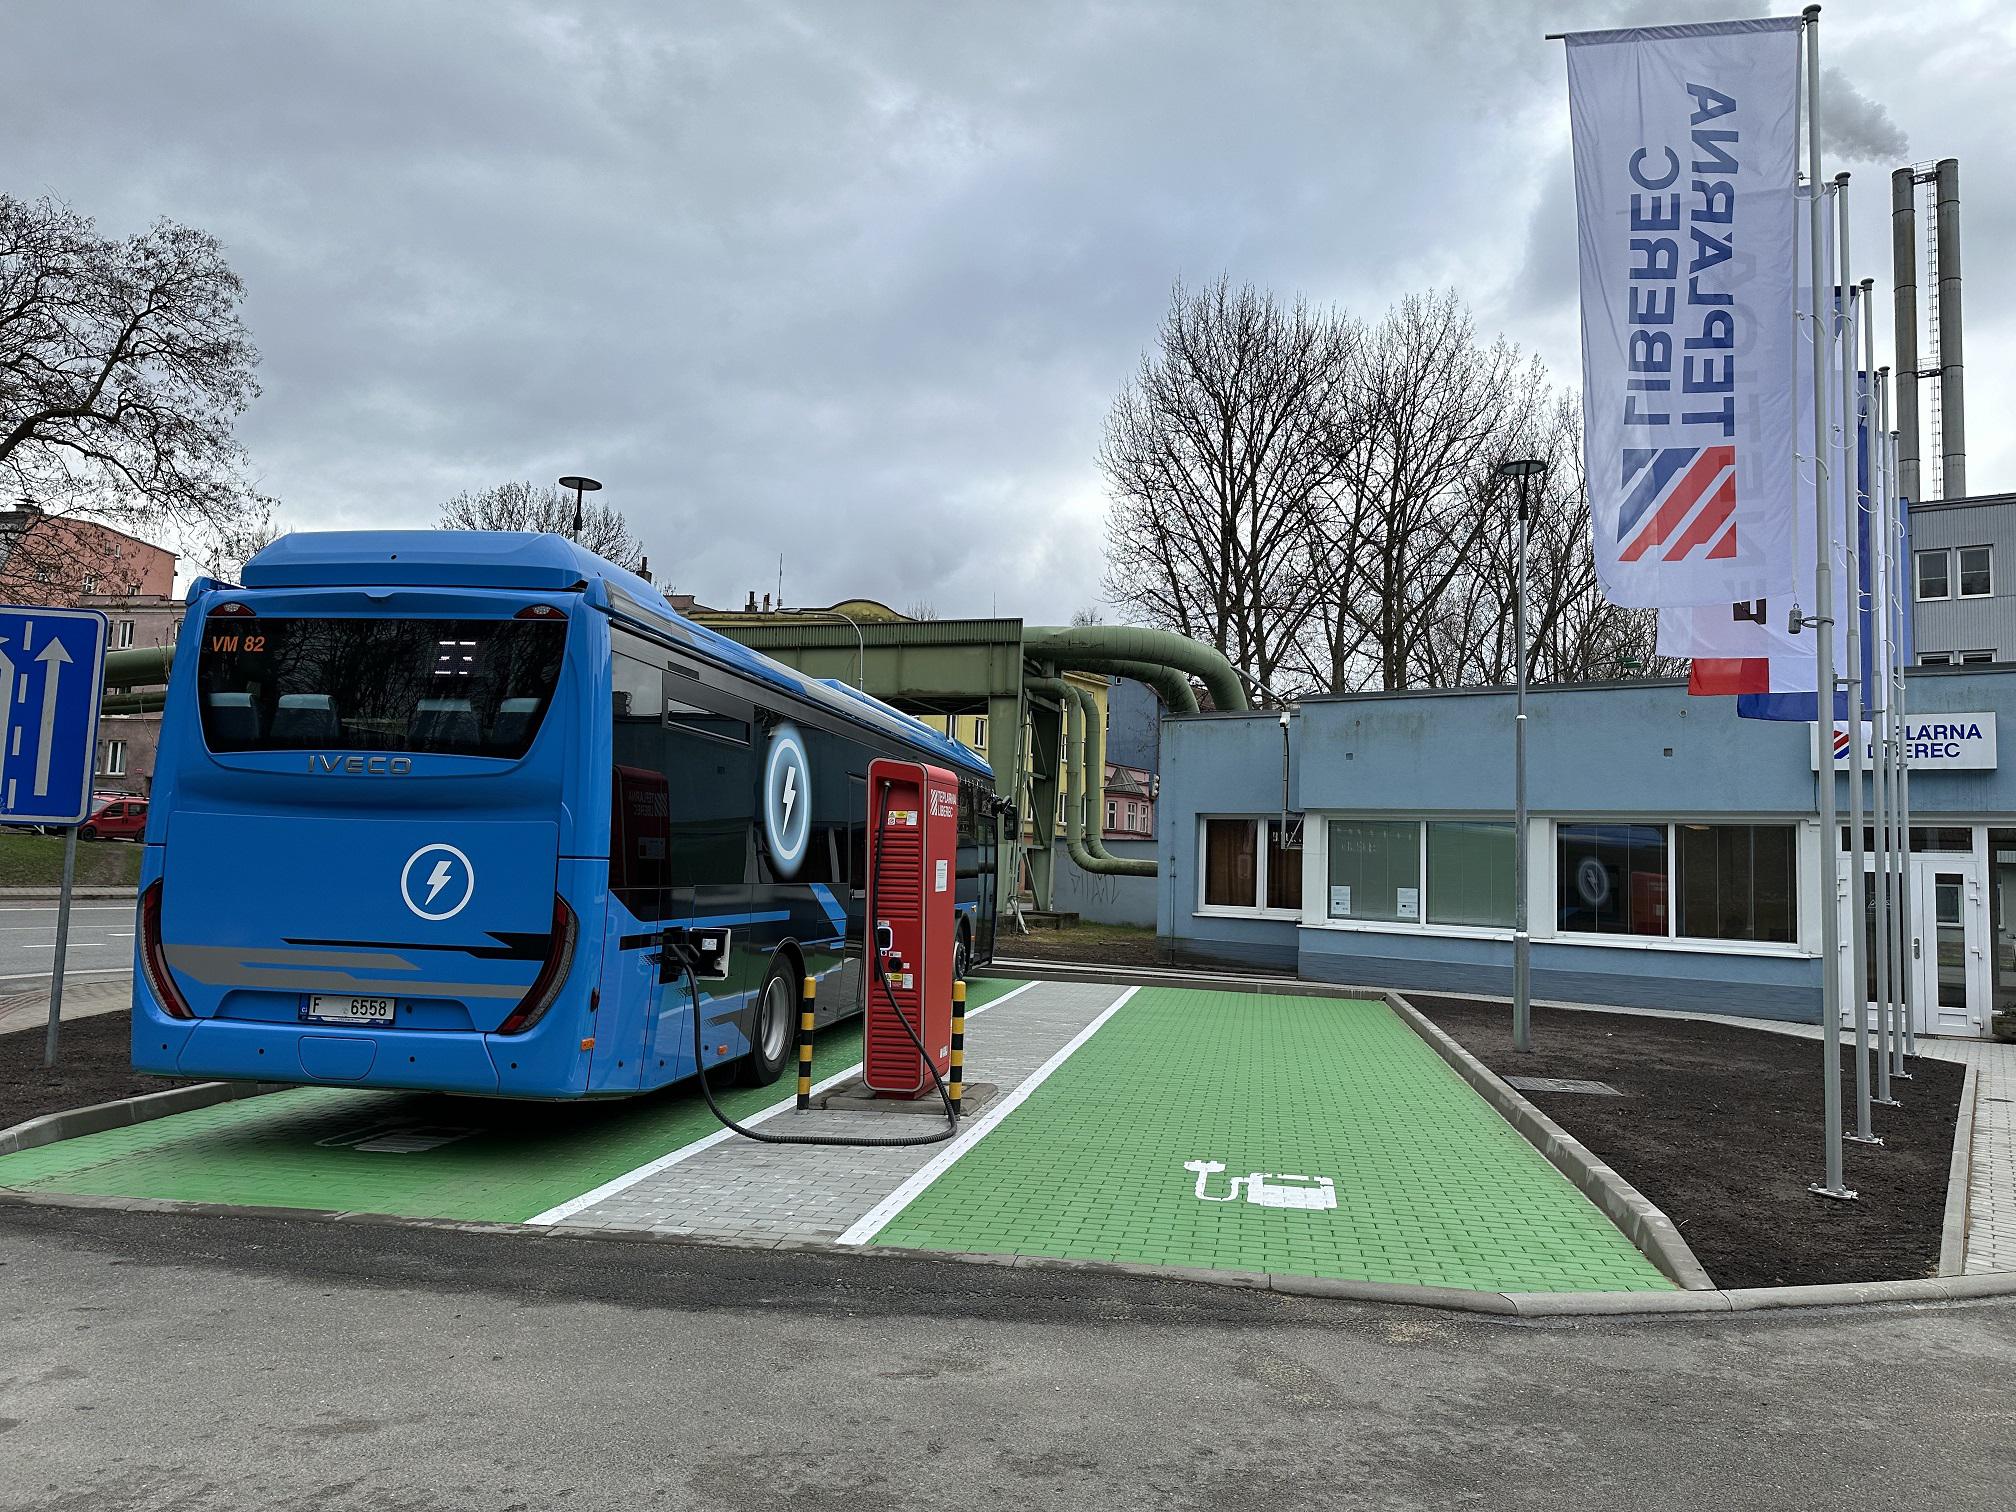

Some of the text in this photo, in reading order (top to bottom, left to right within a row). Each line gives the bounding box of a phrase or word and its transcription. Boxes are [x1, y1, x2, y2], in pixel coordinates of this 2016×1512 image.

[212, 635, 265, 652] VM 82
[1895, 723, 1983, 741] LÁRNA
[308, 754, 412, 774] IVECO
[313, 997, 387, 1016] F 6558
